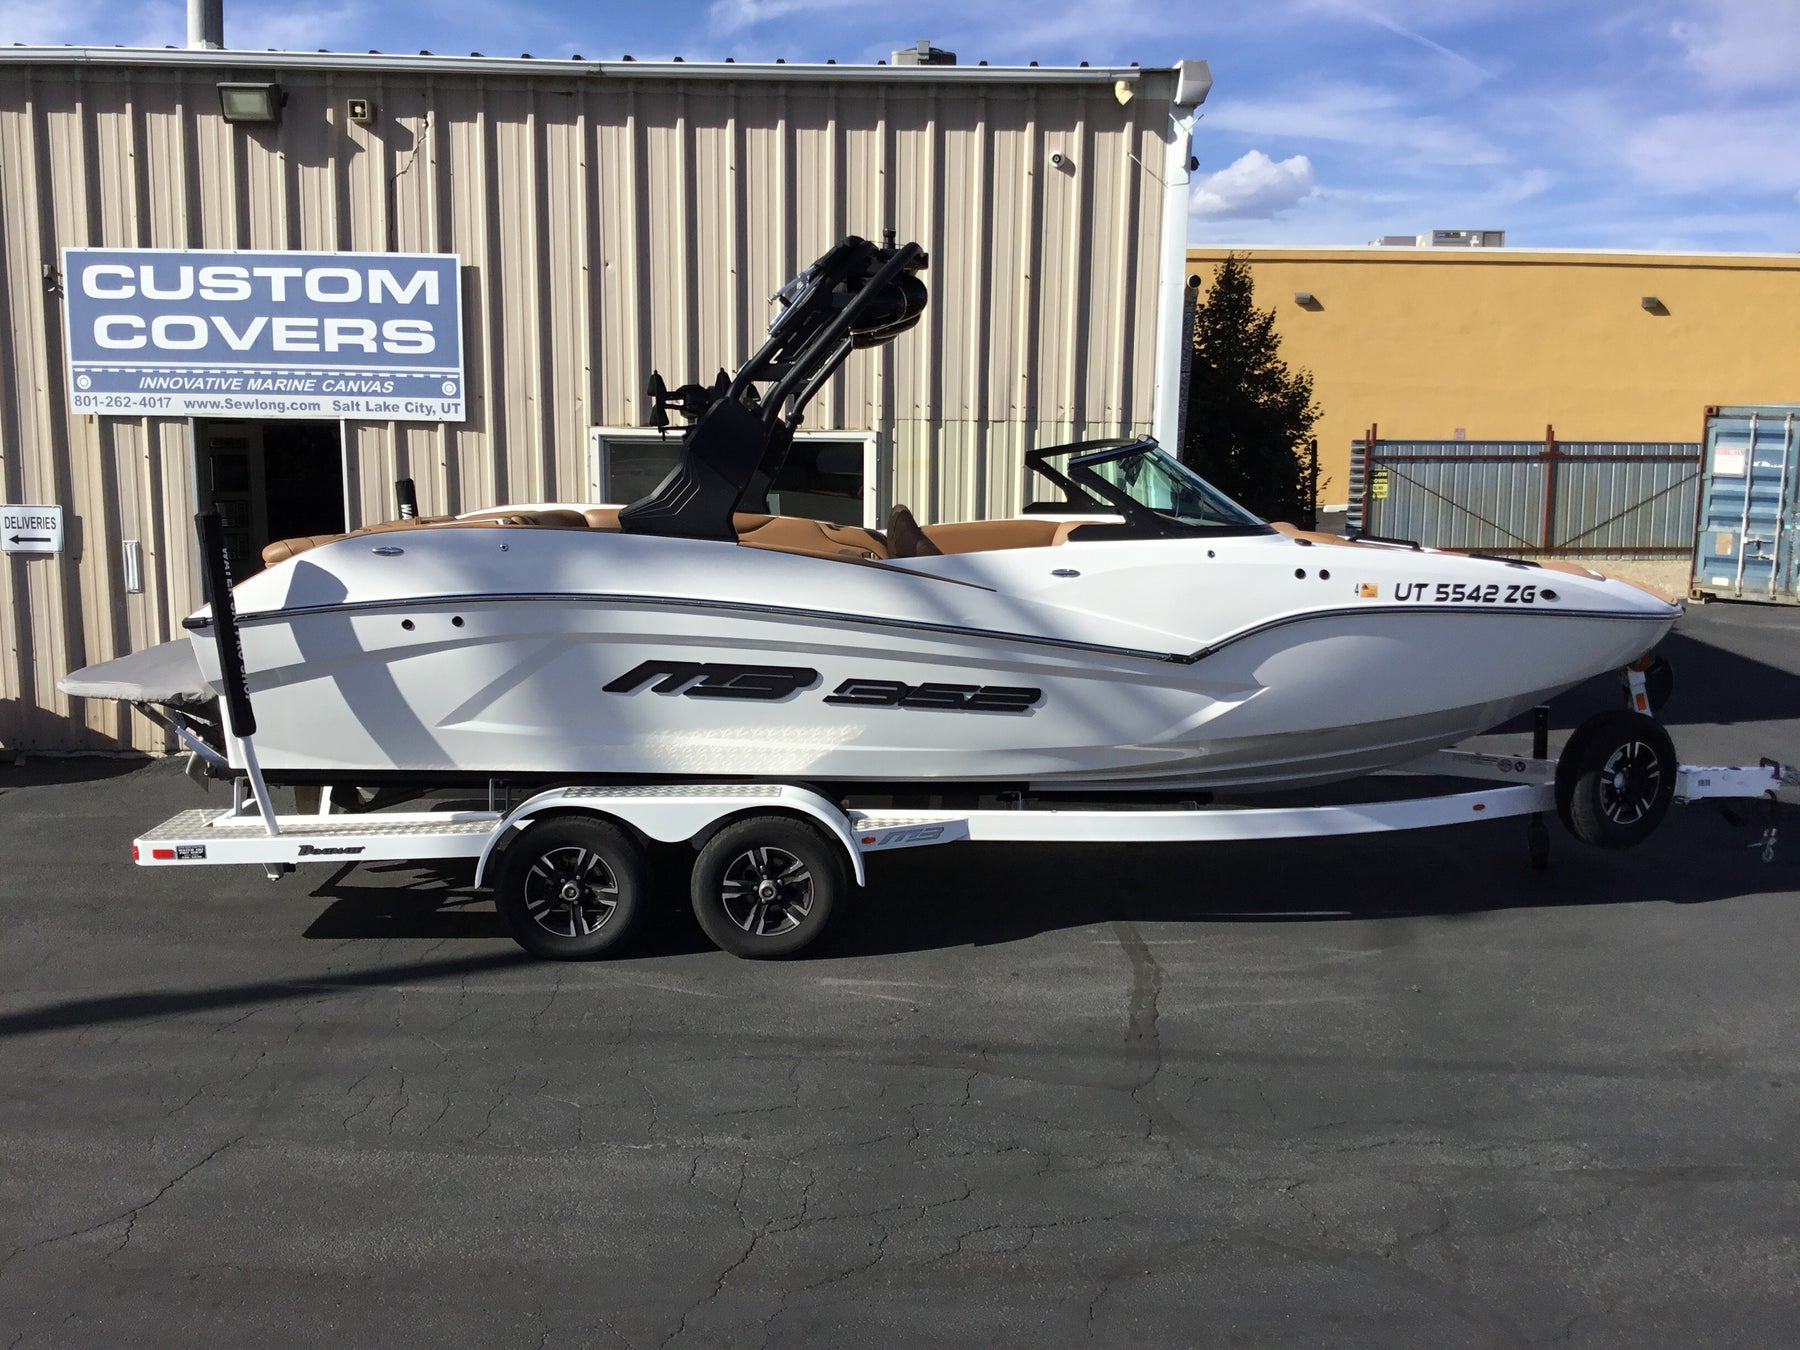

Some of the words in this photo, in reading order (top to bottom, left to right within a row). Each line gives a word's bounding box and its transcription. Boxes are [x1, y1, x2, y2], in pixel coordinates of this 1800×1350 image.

[82, 264, 440, 305] CUSTOM
[93, 314, 436, 355] COVERS
[138, 376, 243, 391] INNOVATIVE
[246, 378, 317, 392] MARINE
[321, 380, 395, 394] CANVAS
[74, 395, 172, 409] 801-262-4017
[184, 398, 321, 413] www.Sewlong.com
[332, 400, 361, 412] Salt
[365, 401, 400, 413] Lake
[404, 402, 436, 415] City,
[441, 402, 461, 414] UT
[4, 516, 57, 530] DELIVERIES
[1394, 582, 1430, 602] UT
[1434, 583, 1499, 603] 5542
[1503, 584, 1537, 604] ZG
